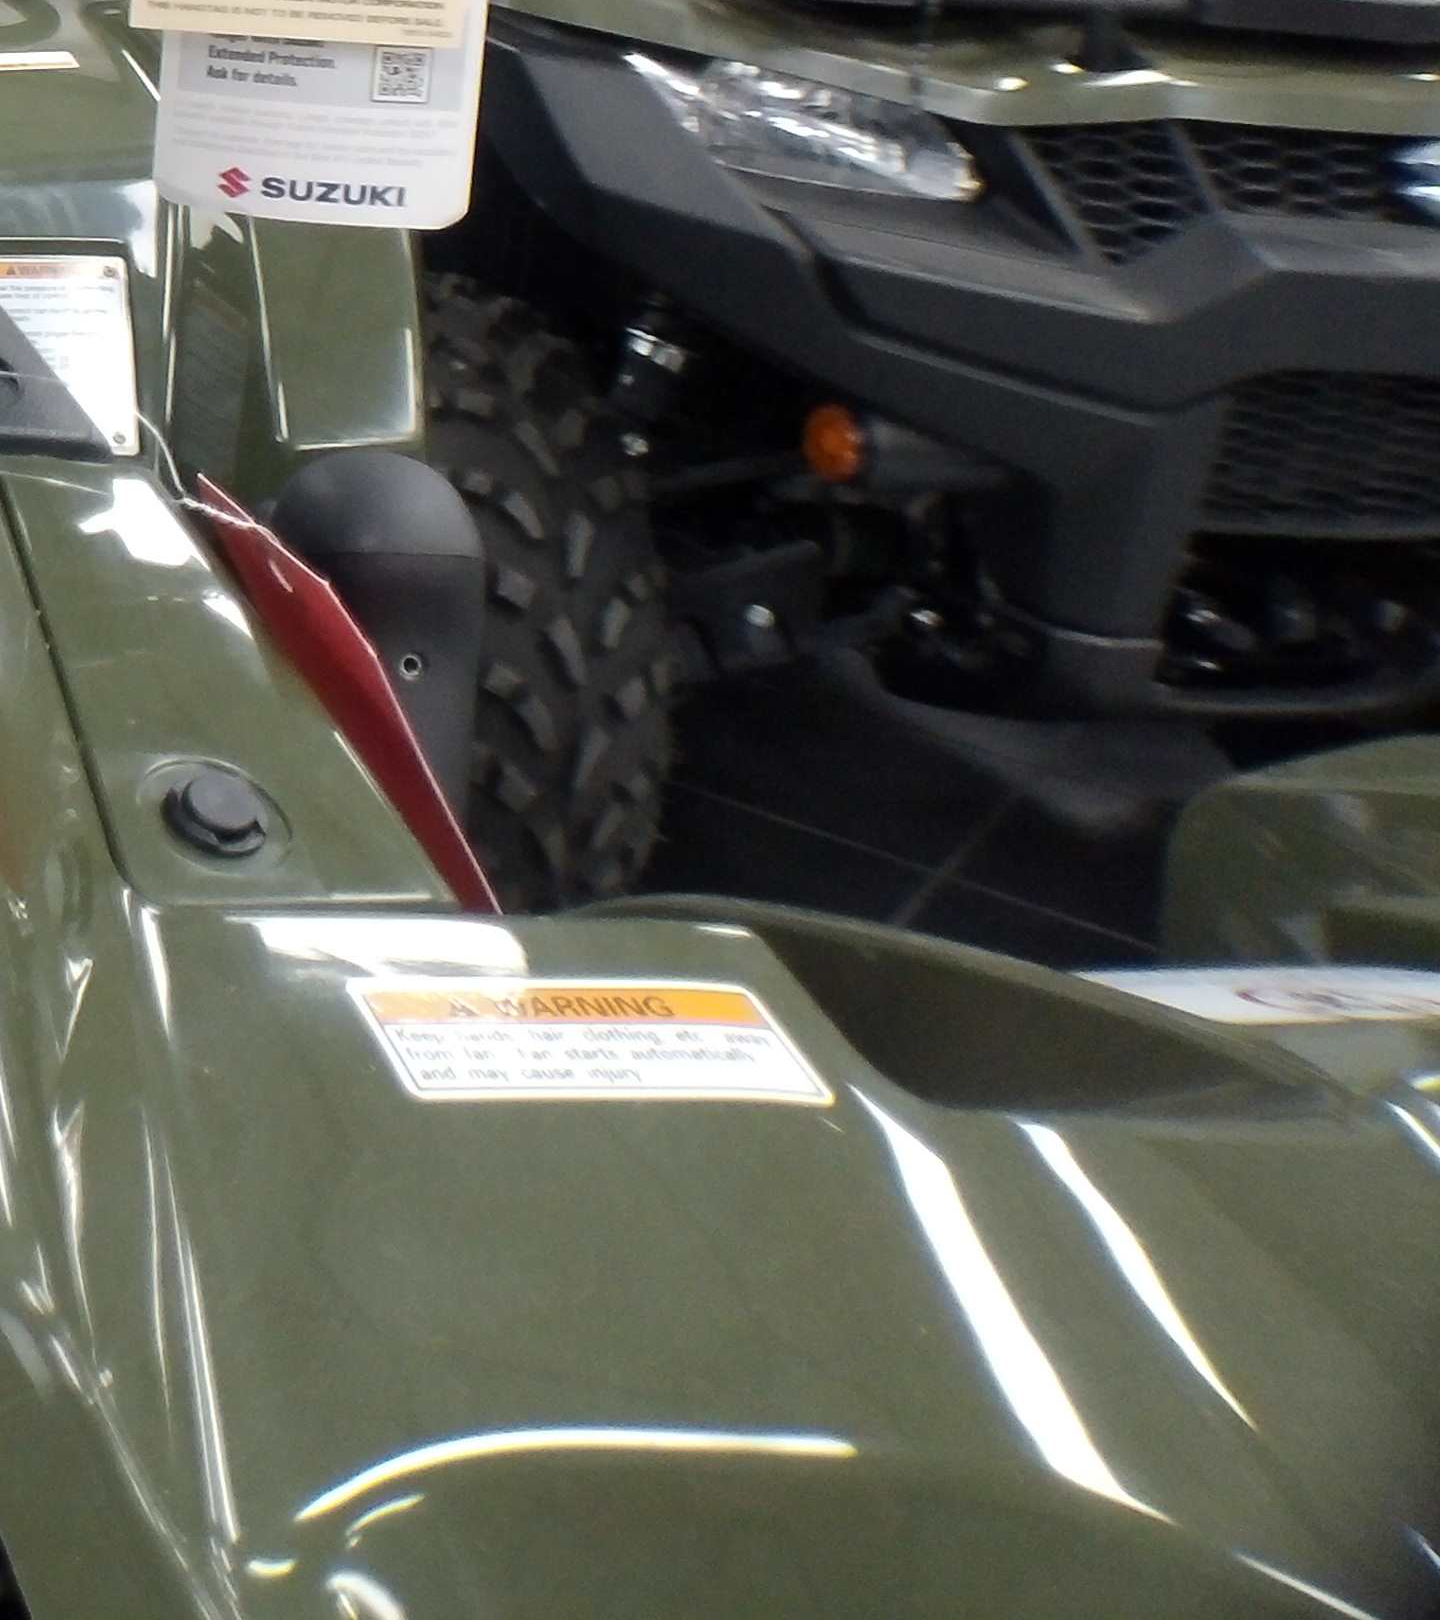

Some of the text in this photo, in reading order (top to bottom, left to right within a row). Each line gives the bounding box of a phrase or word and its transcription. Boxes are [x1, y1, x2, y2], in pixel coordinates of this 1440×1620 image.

[208, 44, 265, 63] Extended
[207, 65, 228, 79] Ask
[232, 68, 249, 81] for
[260, 176, 407, 208] SUZUKI
[490, 995, 675, 1018] WARNING
[395, 1028, 445, 1045] Keep
[421, 1066, 458, 1081] and
[469, 1068, 511, 1083] may
[521, 1067, 576, 1081] cause
